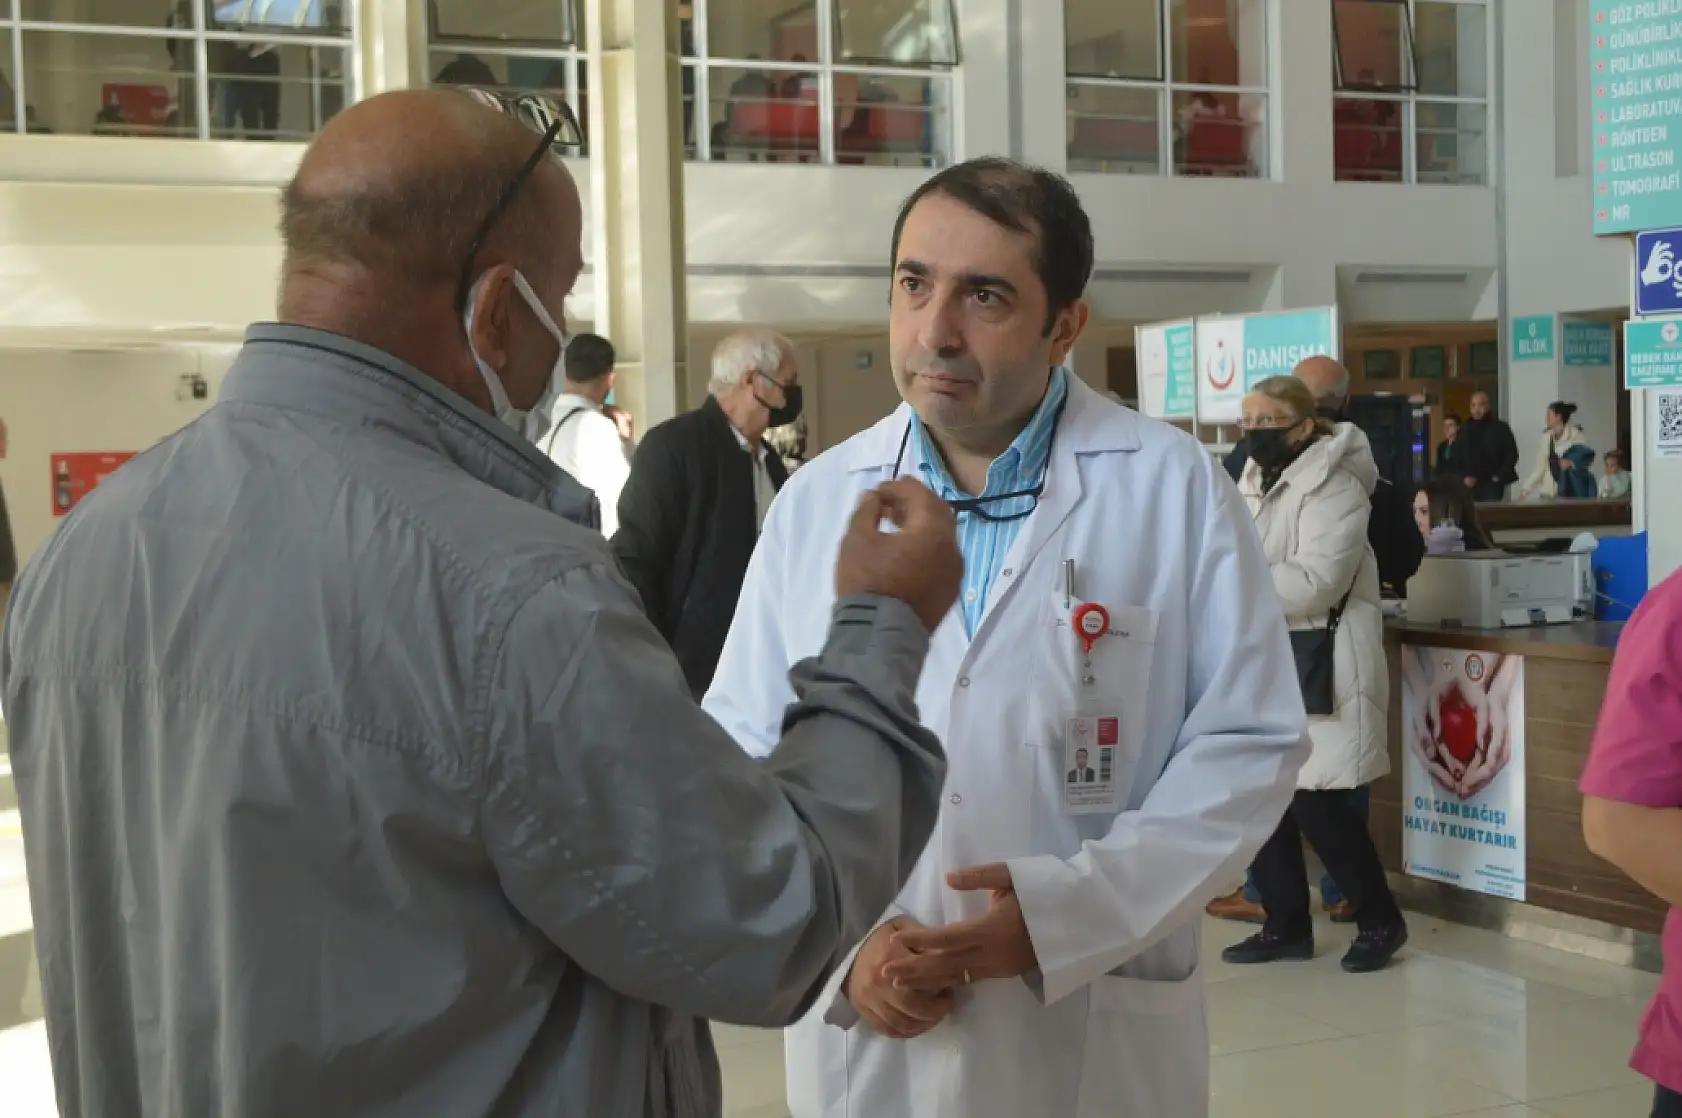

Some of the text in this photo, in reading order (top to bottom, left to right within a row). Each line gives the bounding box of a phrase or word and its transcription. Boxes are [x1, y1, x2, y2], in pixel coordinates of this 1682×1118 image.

[1655, 71, 1682, 92] KUR
[1611, 97, 1682, 123] LABORATUV
[1611, 124, 1667, 148] RÖNTGEN
[1611, 148, 1673, 172] ULTRASON
[1612, 168, 1680, 197] TOMOGRAFİ
[1613, 204, 1630, 221] MR
[1404, 814, 1517, 849] HAYAT KURTARIR
